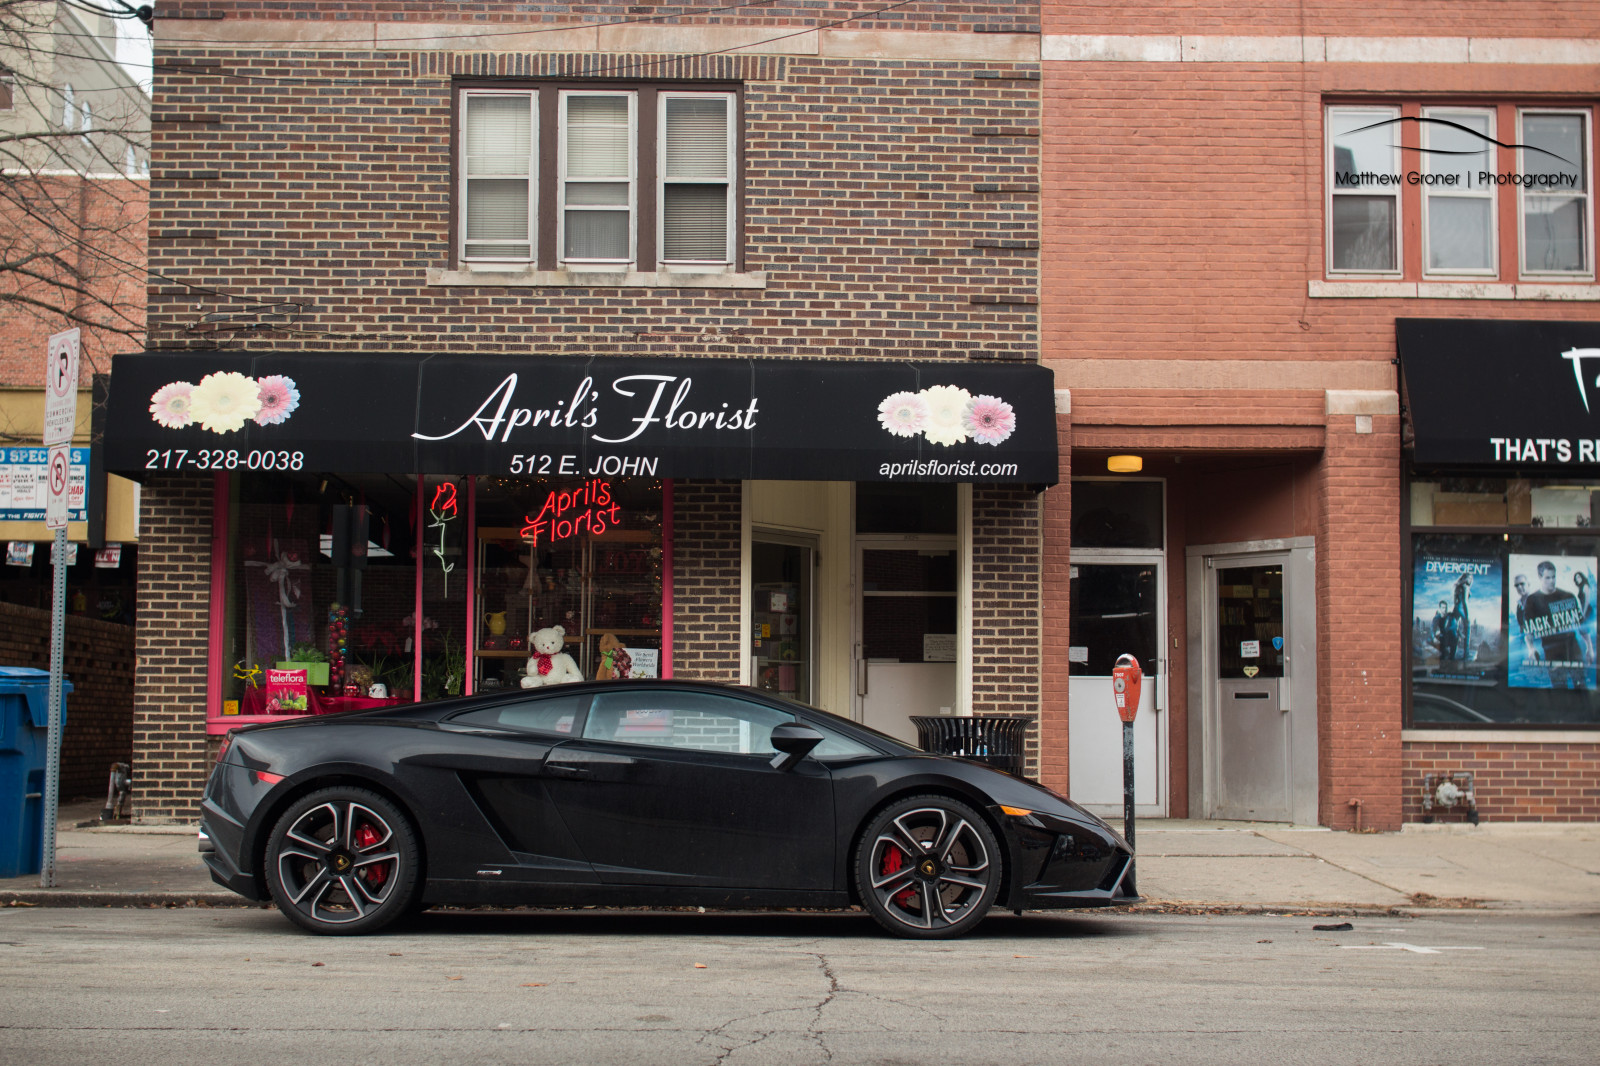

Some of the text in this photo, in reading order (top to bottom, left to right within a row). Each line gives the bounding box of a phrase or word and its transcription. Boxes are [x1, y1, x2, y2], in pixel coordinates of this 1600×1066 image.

[46, 407, 74, 418] COMMERCIAL
[410, 373, 758, 443] April's Florist
[145, 449, 305, 471] 217-328-0038
[1490, 438, 1571, 462] THAT'S
[509, 455, 659, 476] 512 E. JOHN
[878, 459, 1018, 479] aprilsflorist.com
[525, 478, 612, 525] April's
[520, 501, 621, 548] Florist
[1425, 561, 1492, 575] DIVERGENT
[1523, 615, 1551, 634] JACK
[270, 673, 304, 683] teleflora
